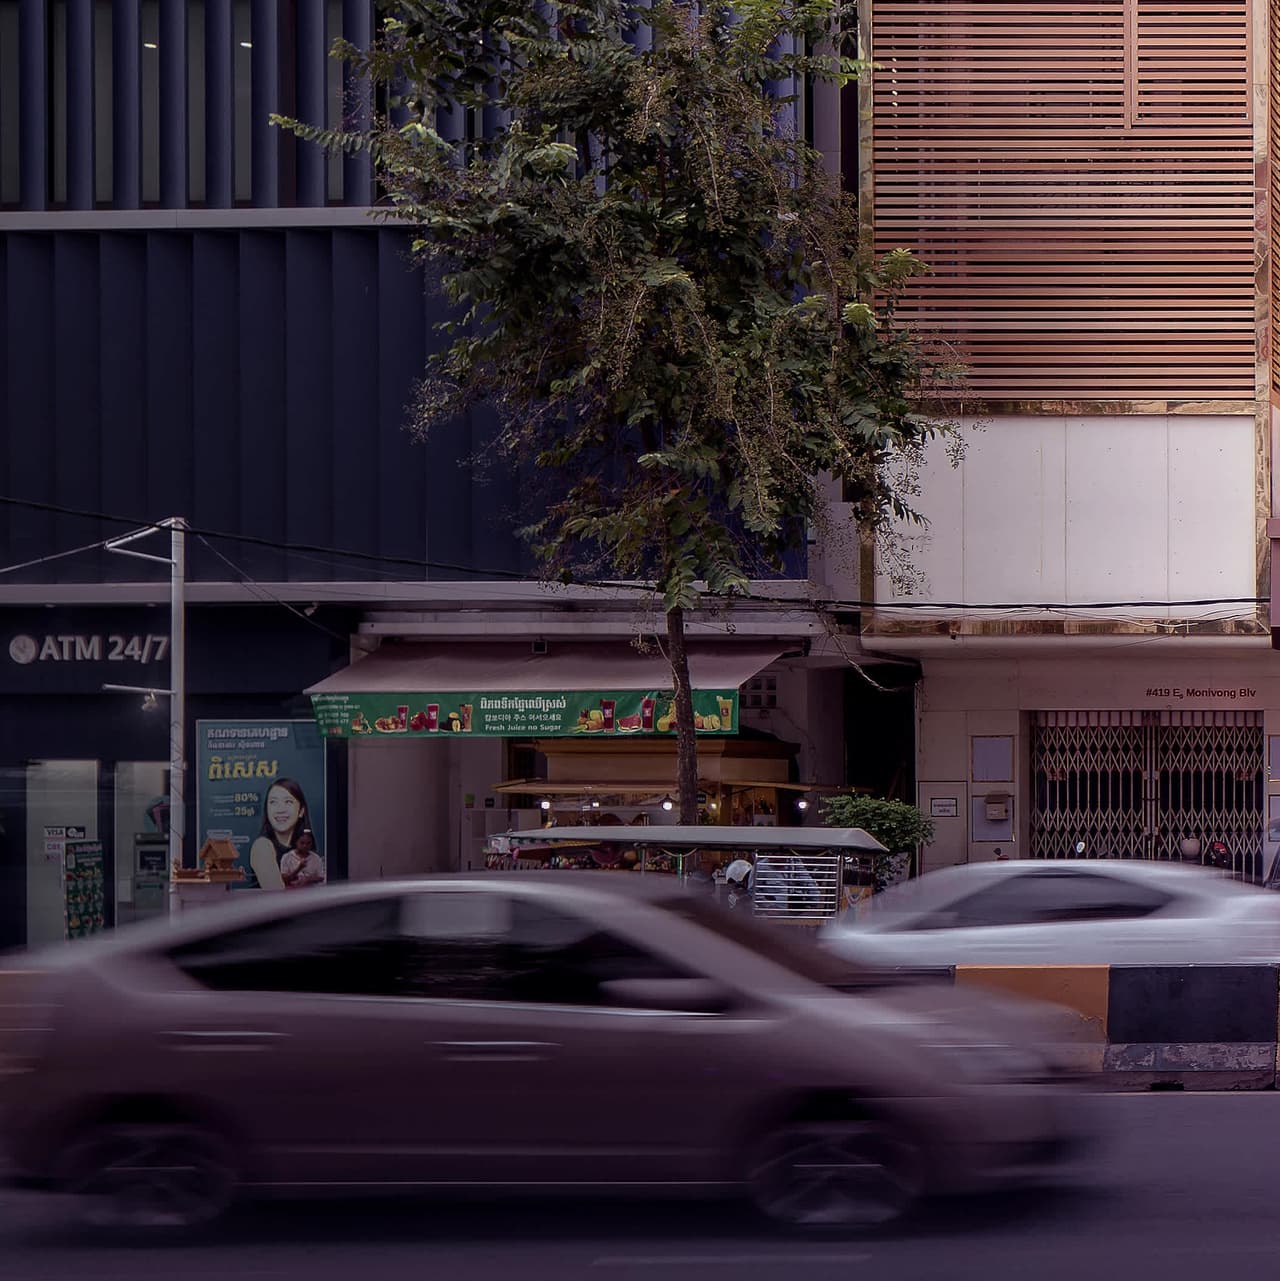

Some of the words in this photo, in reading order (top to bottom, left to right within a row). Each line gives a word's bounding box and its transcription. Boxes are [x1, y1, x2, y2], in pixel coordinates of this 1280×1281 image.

[39, 635, 100, 661] ATM
[108, 634, 169, 664] 24/7
[1146, 688, 1170, 697] #419
[1186, 687, 1237, 699] Monivong
[1239, 687, 1257, 697] Blv
[540, 724, 561, 732] Sugar
